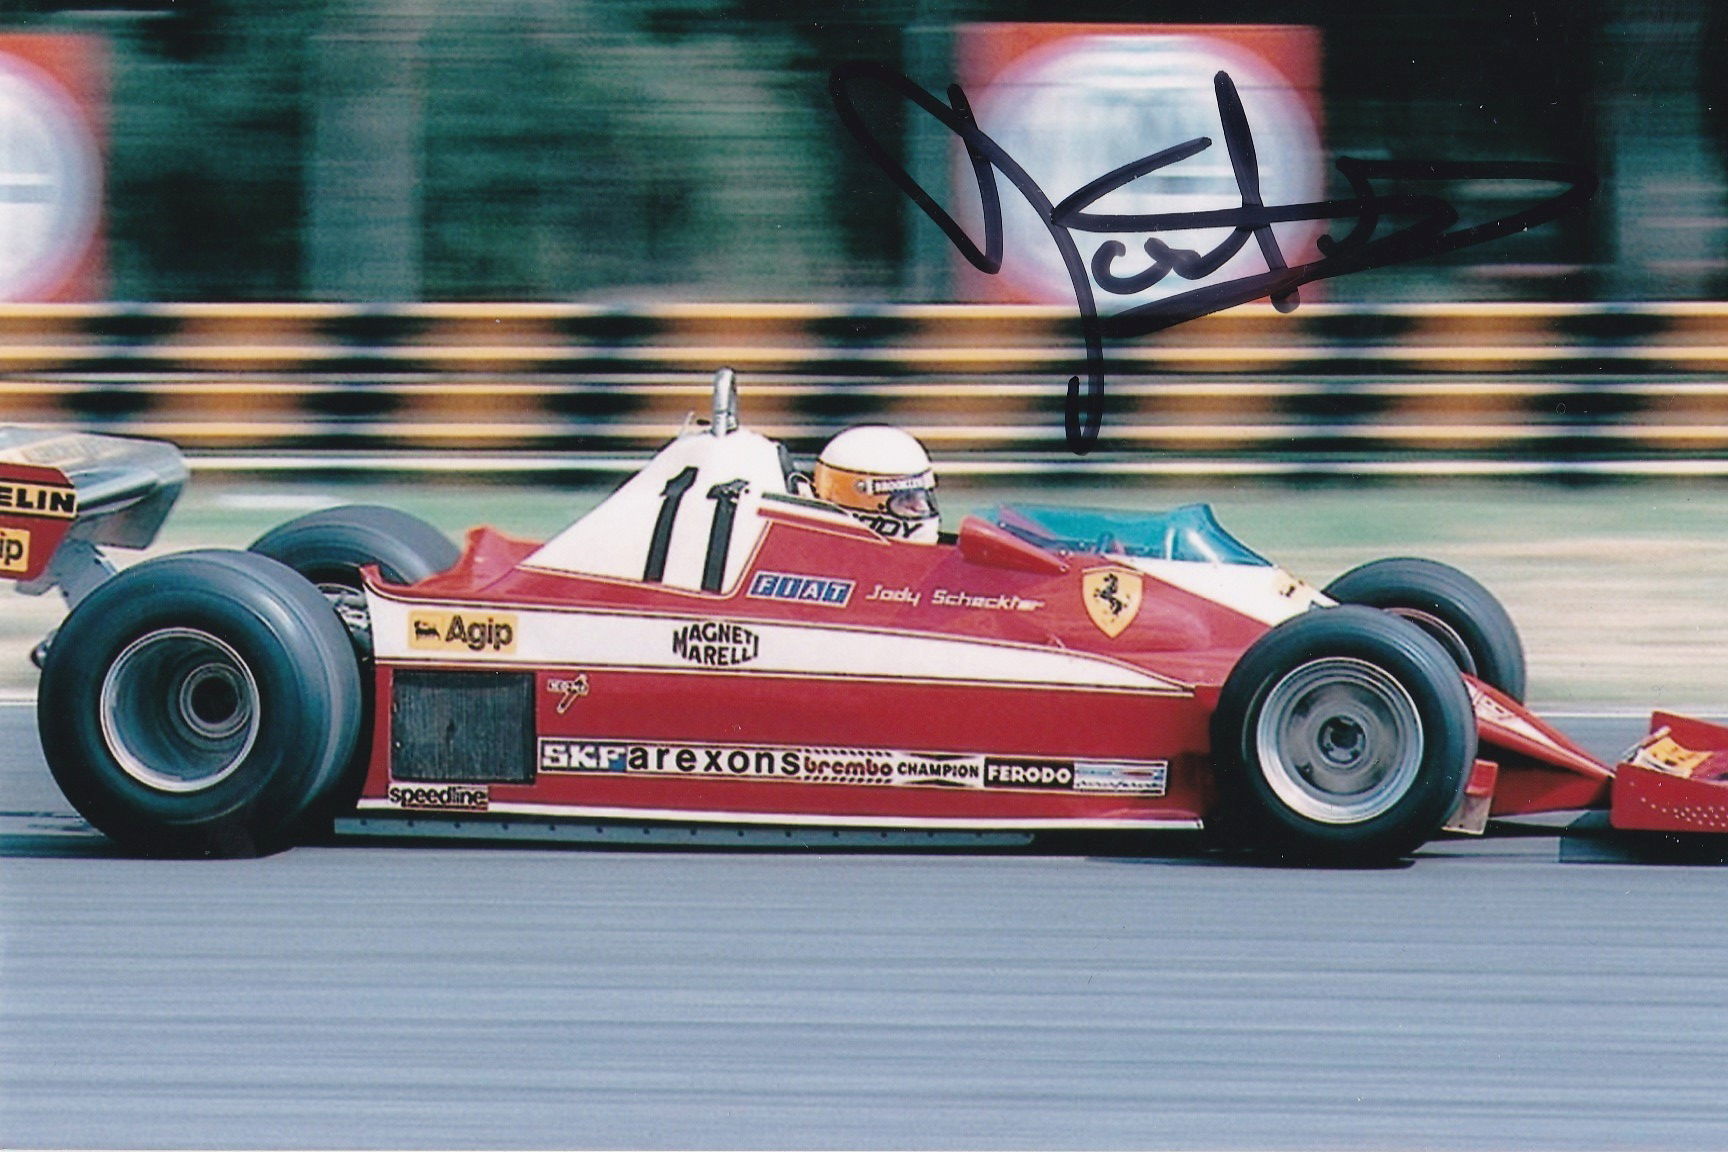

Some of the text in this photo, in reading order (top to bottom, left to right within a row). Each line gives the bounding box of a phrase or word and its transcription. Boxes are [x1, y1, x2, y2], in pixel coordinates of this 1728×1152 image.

[643, 466, 750, 595] 11
[757, 577, 847, 602] FIAT
[866, 584, 921, 606] Jody
[445, 614, 513, 651] Agip
[672, 622, 759, 651] MAGNETI
[672, 639, 759, 666] MARELLI
[543, 743, 626, 770] SKF
[628, 746, 801, 775] arexons
[804, 756, 893, 777] brembo
[897, 761, 979, 778] CHAMPION
[987, 764, 1071, 784] FERODO
[389, 786, 487, 808] speedline
